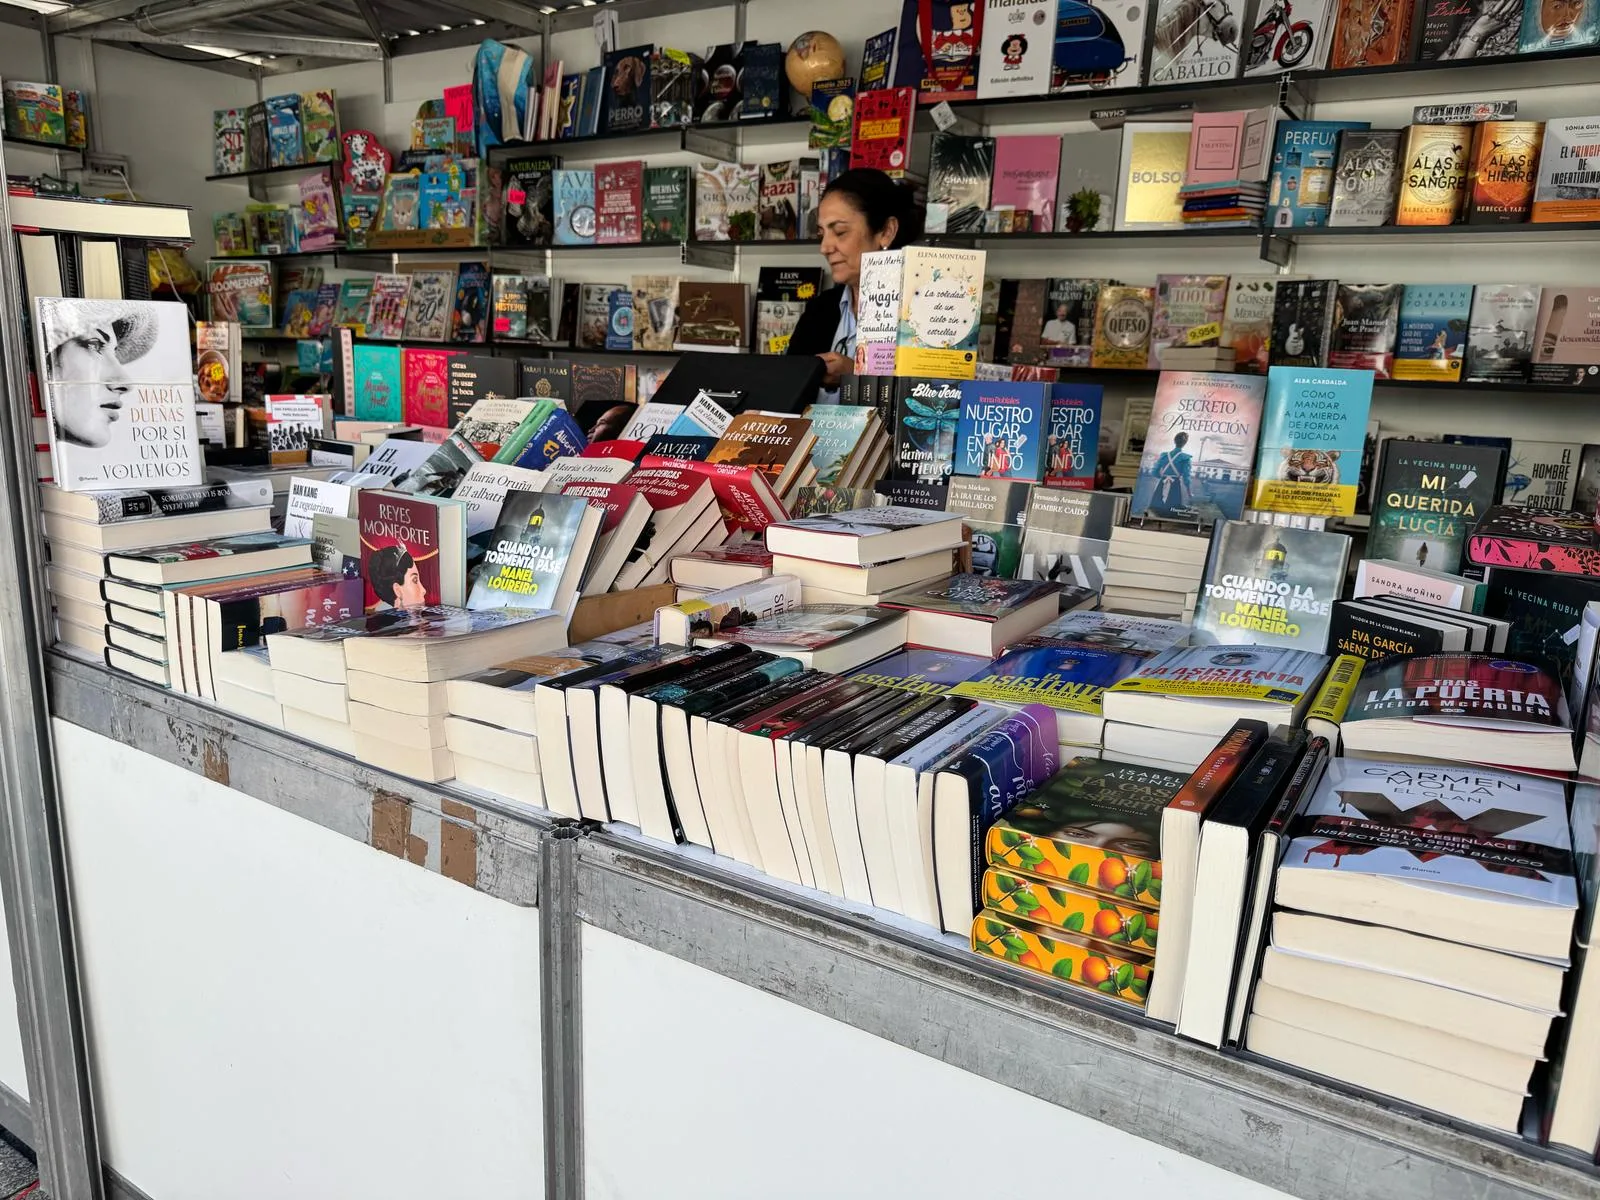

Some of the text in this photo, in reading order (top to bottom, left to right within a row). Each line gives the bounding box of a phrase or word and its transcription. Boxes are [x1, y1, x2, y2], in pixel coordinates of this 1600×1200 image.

[1153, 60, 1231, 82] CABALLO
[990, 76, 1009, 84] Edición
[608, 105, 643, 122] PERRO
[1095, 109, 1126, 119] CHANEL
[1560, 146, 1569, 159] EL
[1412, 156, 1454, 170] ALAS
[1489, 155, 1527, 167] ALAS
[1577, 158, 1587, 171] DE
[944, 176, 979, 185] CHANEL
[1409, 175, 1466, 190] SANGRE
[651, 184, 681, 195] HIERBAS
[761, 180, 796, 197] caza
[1477, 205, 1508, 213] REBECCA
[917, 251, 977, 261] ELENA MONTAGUD
[209, 274, 271, 293] BOOMERANG
[877, 280, 886, 290] La
[924, 289, 966, 299] La soledad
[934, 303, 943, 311] de
[930, 316, 960, 325] cielo sin
[1109, 317, 1147, 335] QUESO
[1342, 318, 1389, 327] Juan Manuel
[927, 329, 957, 337] estrellas
[451, 371, 477, 379] maneras
[452, 388, 474, 396] la boca
[910, 383, 937, 398] Blue
[1190, 380, 1229, 389] FERNÁNDEZ
[138, 387, 183, 404] MARÍA
[698, 397, 727, 423] HAN KANG
[1178, 399, 1237, 415] SECRETO
[1294, 401, 1340, 410] MANDAR
[131, 404, 185, 423] DUEÑAS
[966, 404, 1033, 424] NUESTRO
[1284, 410, 1348, 421] A LA MIERDA
[740, 421, 788, 434] ARTURO
[974, 421, 1020, 439] LUGAR
[1163, 410, 1250, 436] PERFECCIÓN
[1288, 420, 1340, 431] DE FORMA
[132, 426, 187, 442] POR SI
[723, 431, 792, 447] PÉREZ-REVERTE
[1287, 431, 1337, 441] EDUCADA
[140, 441, 188, 460] UN DÍA
[653, 441, 701, 455] JAVIER
[902, 442, 910, 450] LA
[966, 436, 985, 453] EN
[966, 452, 1024, 471] MUNDO
[1562, 448, 1571, 465] EL
[102, 461, 190, 480] VOLVEMOS
[911, 462, 953, 476] PIENSO
[1413, 459, 1445, 469] VECINA
[1449, 463, 1477, 472] RUBIA
[1531, 464, 1570, 481] HOMBRE
[467, 471, 495, 484] María
[654, 470, 683, 480] CERCAS
[1421, 473, 1446, 492] MI
[304, 486, 319, 499] KANG
[458, 486, 472, 498] El
[585, 487, 611, 498] CERCAS
[651, 479, 690, 491] de Dios en
[651, 487, 679, 498] mundo
[967, 484, 990, 492] Márkaris
[1555, 481, 1567, 496] DE
[903, 489, 930, 497] TIENDA
[950, 491, 960, 499] LA
[983, 494, 997, 502] LOS
[1033, 494, 1090, 506] Fernando Aramburu
[291, 497, 299, 507] La
[606, 502, 619, 512] en
[910, 497, 939, 506] DESEOS
[949, 500, 994, 511] HUMILLADOS
[1386, 493, 1475, 517] QUERIDA
[379, 503, 411, 524] REYES
[1032, 502, 1090, 517] HOMBRE CAÍDO
[1398, 512, 1456, 537] LUCÍA
[363, 520, 430, 546] MONFORTE
[497, 540, 554, 561] CUANDO LA
[484, 550, 563, 574] TORMENTA PASE
[499, 566, 534, 582] MANEL
[487, 578, 538, 596] LOUREIRO
[1222, 574, 1315, 600] CUANDO LA
[1371, 577, 1402, 590] SANDRA
[1406, 586, 1443, 601] MOÑINO
[1205, 584, 1329, 616] TORMENTA PASE
[1503, 587, 1580, 617] LA VECINA RUBIA
[1235, 602, 1289, 623] MANEL
[1219, 612, 1301, 638] LOUREIRO
[1382, 624, 1399, 632] CIUDAD
[1337, 638, 1369, 658] SÁENZ
[1351, 629, 1414, 655] EVA GARCÍA
[1043, 672, 1062, 681] LA
[1139, 667, 1305, 686] LA ASISTENTA
[1433, 679, 1479, 687] TRAS
[1367, 686, 1550, 708] LA PUERTA
[1363, 699, 1550, 717] FREIDA McFADDEN
[1119, 768, 1181, 784] ISABEL
[1363, 767, 1522, 793] CARMEN
[1385, 776, 1495, 797] MOLA
[1393, 787, 1482, 805] EL CLAN
[1360, 822, 1419, 837] BRUTAL
[1421, 831, 1517, 850] DESENLACE
[1379, 831, 1471, 850] DE LA SERIE
[1312, 827, 1545, 868] INSPECTORA ELENA BLANCO
[1411, 866, 1441, 875] Planeta
